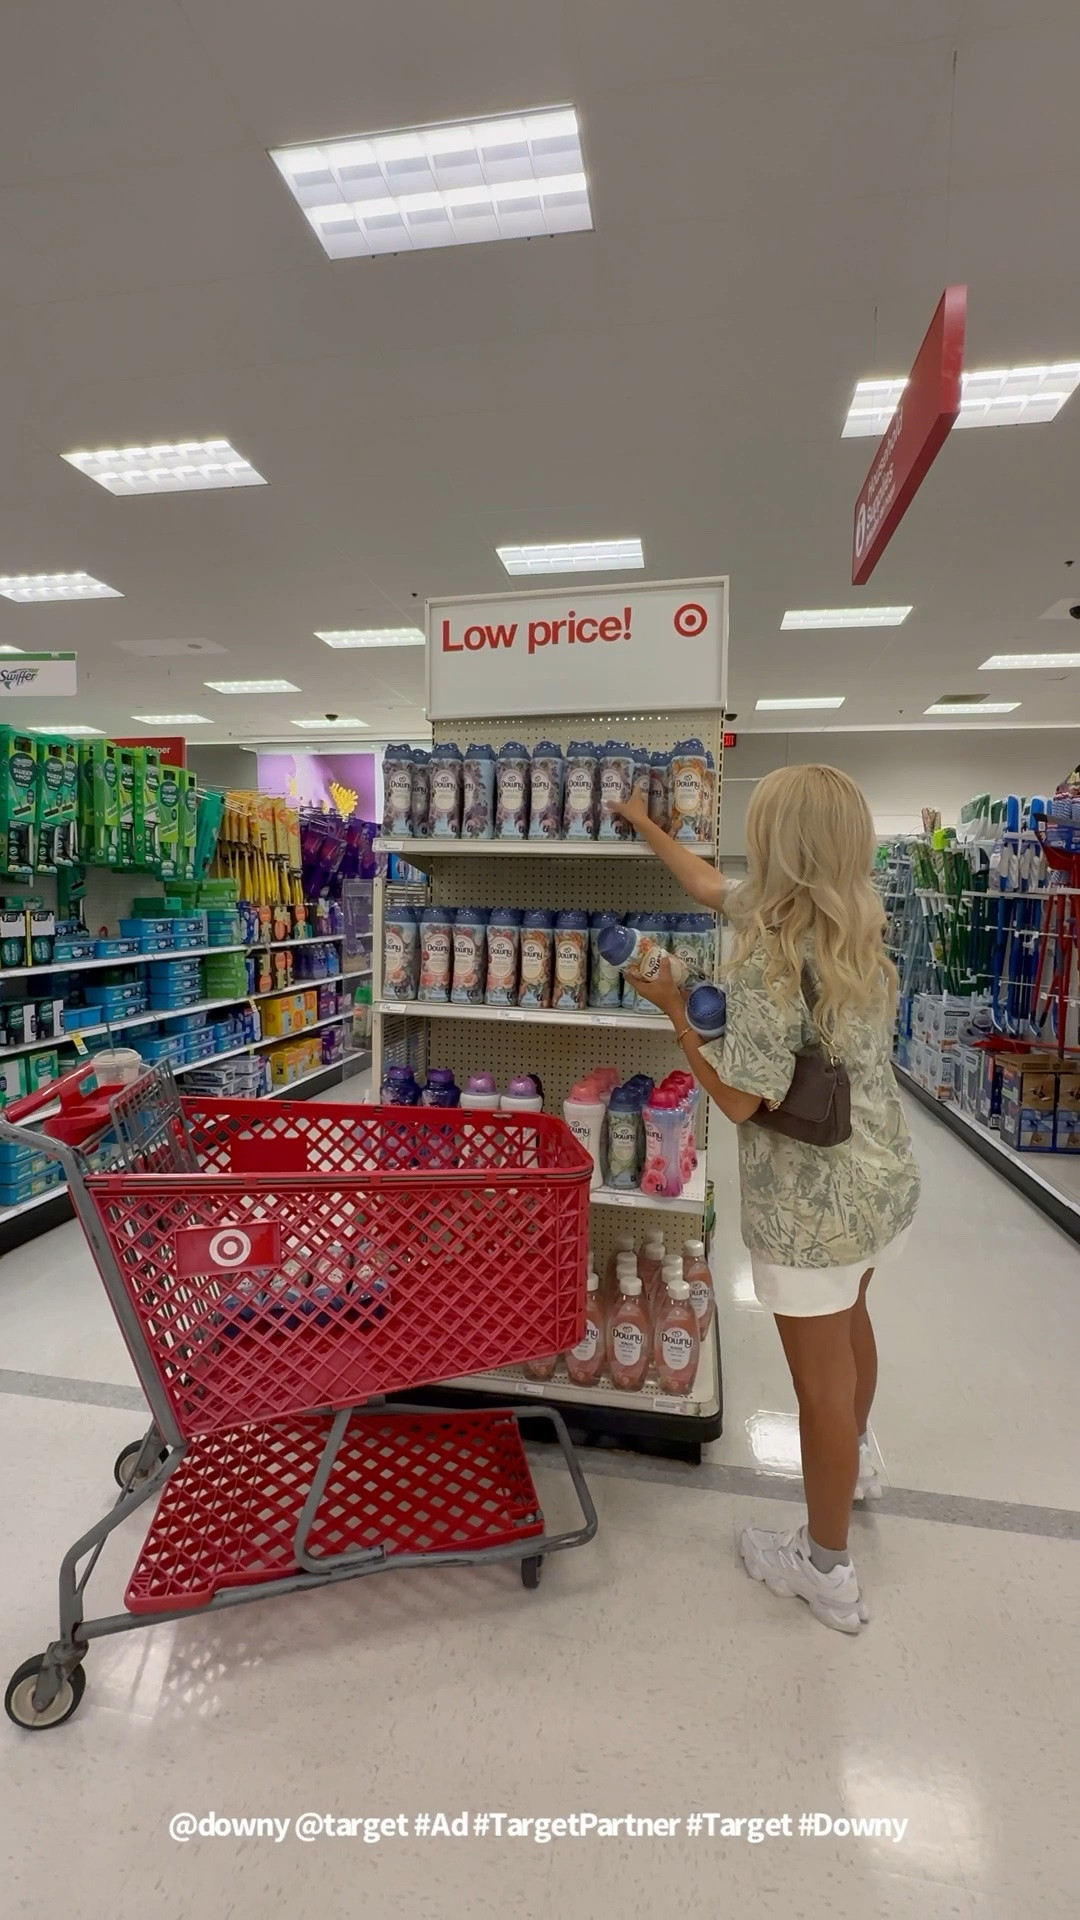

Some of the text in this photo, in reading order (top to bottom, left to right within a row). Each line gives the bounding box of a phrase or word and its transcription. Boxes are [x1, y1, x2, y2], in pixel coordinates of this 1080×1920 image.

[442, 606, 632, 654] Low price!
[0, 669, 38, 685] Swiffer
[390, 781, 411, 792] Downy
[433, 781, 456, 792] Downy
[502, 781, 523, 791] Downy
[532, 781, 549, 791] owny
[569, 780, 592, 790] Downy
[677, 780, 699, 790] Downy
[428, 944, 449, 954] Downy
[491, 947, 512, 958] Downy
[558, 952, 578, 962] Downy
[613, 1131, 636, 1141] Downy
[646, 1130, 663, 1142] owny
[613, 1328, 643, 1344] Downy
[661, 1333, 692, 1349] Downy
